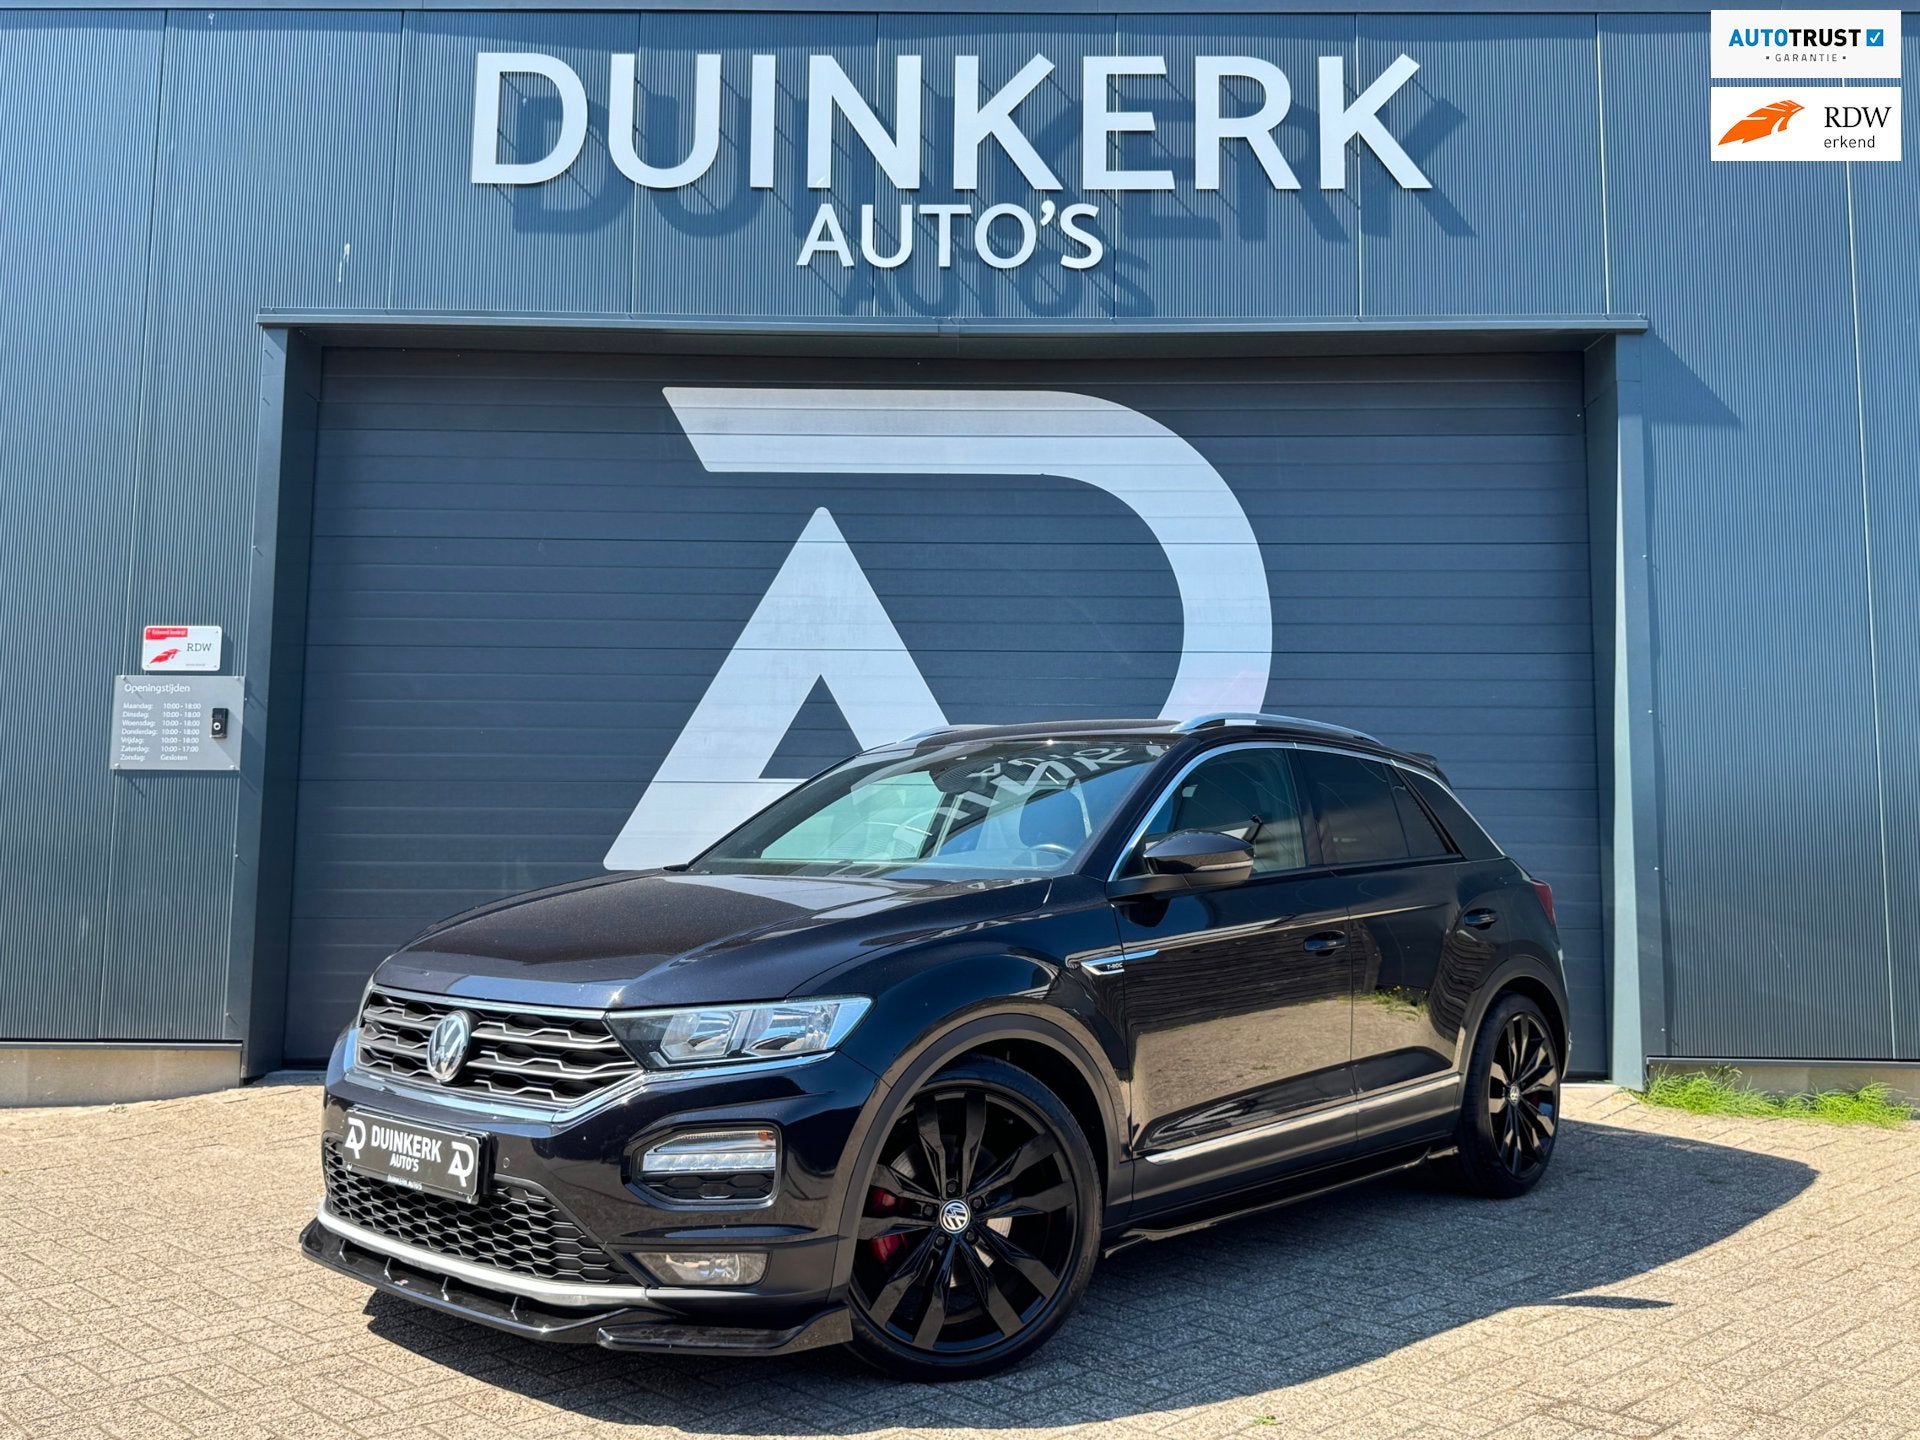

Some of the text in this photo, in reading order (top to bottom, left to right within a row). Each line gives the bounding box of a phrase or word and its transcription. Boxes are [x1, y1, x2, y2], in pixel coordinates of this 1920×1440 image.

[470, 51, 1433, 191] DUINKERK
[796, 200, 1104, 270] AUTO'S
[186, 642, 212, 652] RDW
[124, 684, 191, 694] Openingstijden
[370, 1124, 442, 1163] DUINKERK
[389, 1152, 420, 1173] AUTO'S
